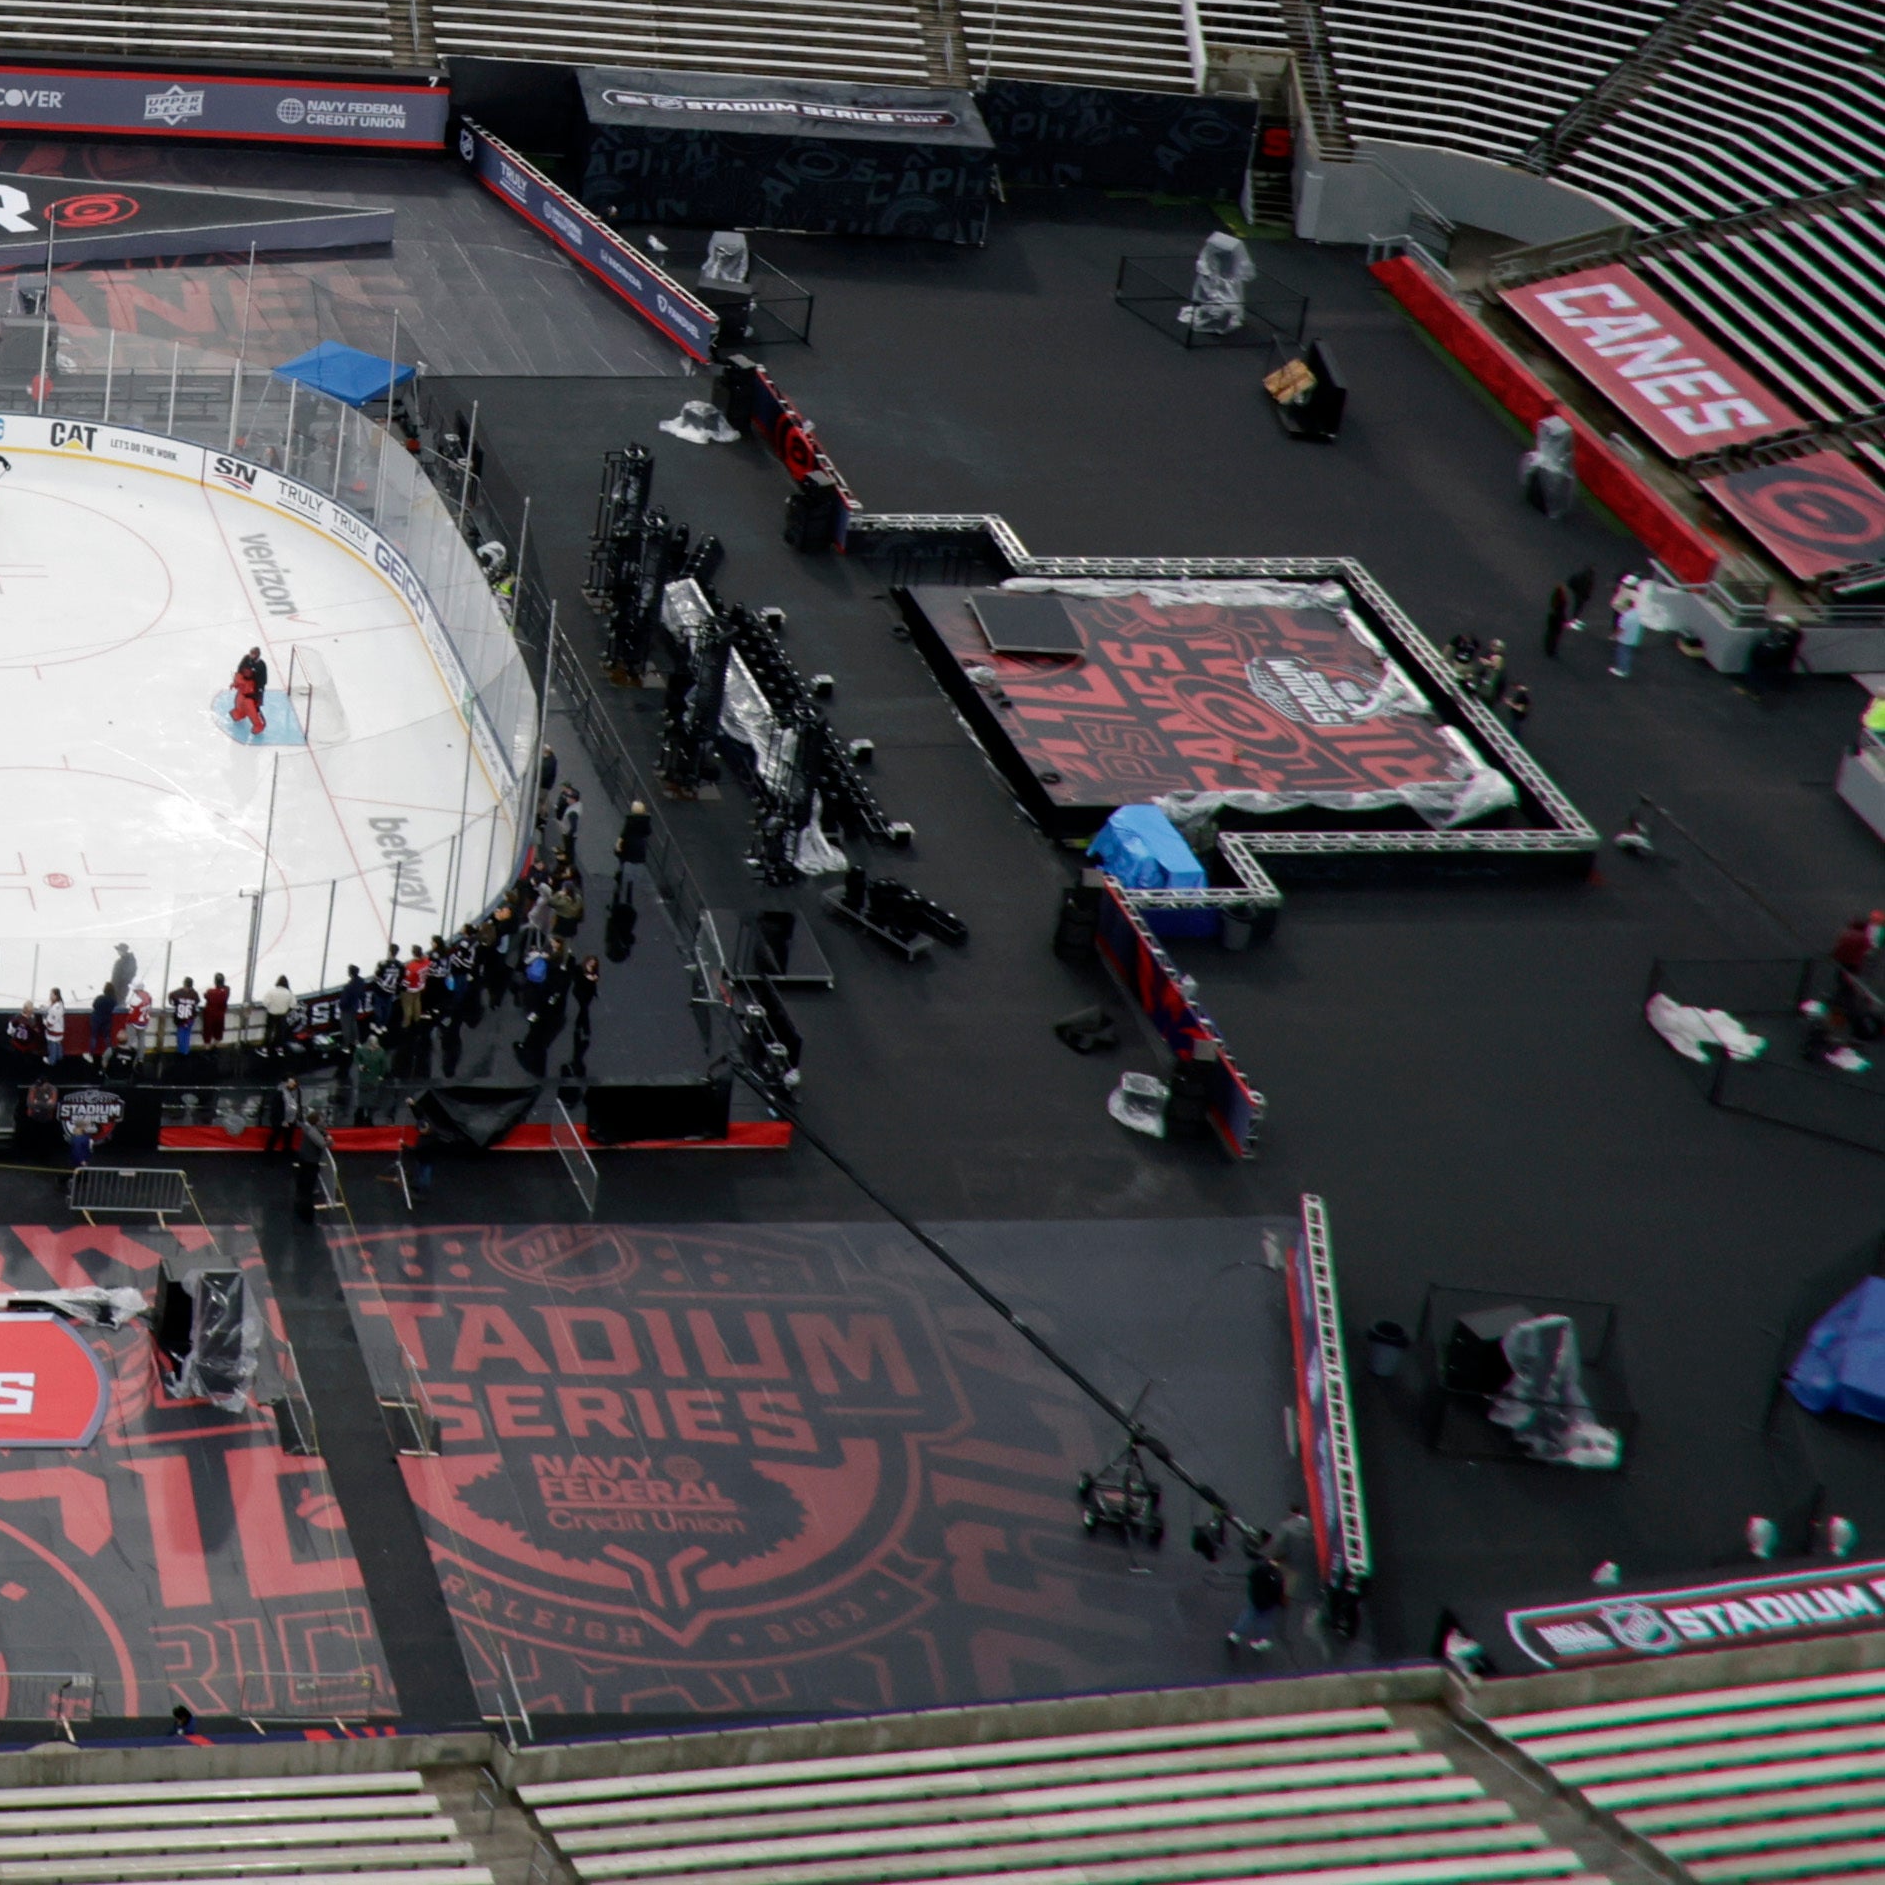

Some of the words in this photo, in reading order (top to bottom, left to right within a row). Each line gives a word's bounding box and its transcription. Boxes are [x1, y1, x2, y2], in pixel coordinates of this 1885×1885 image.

[429, 76, 438, 88] 7
[147, 94, 201, 109] UPPER
[307, 100, 345, 115] NAVY
[348, 102, 406, 117] FEDERAL
[686, 101, 798, 115] STADIUM
[803, 106, 894, 123] SERIES
[306, 113, 360, 127] CREDIT
[363, 114, 406, 128] UNION
[1261, 128, 1292, 157] S
[500, 161, 529, 193] TRULY
[1535, 278, 1771, 438] CANES
[51, 422, 98, 452] CAT
[111, 439, 128, 450] LET'S
[141, 444, 155, 456] THE
[157, 447, 177, 460] WORK
[278, 481, 324, 513] TRULY
[332, 508, 370, 542] TRULY
[240, 532, 297, 615] verizon
[374, 542, 427, 623] GEICO
[1266, 660, 1343, 724] STADIUM
[367, 817, 437, 914] betway
[177, 1004, 193, 1019] 96
[59, 1103, 122, 1118] STADIUM
[412, 1382, 820, 1453] SERIES
[529, 1454, 653, 1480] NAVY
[538, 1477, 726, 1504] FEDERAL
[545, 1508, 646, 1533] Credit
[650, 1511, 747, 1536] Union
[439, 1573, 645, 1649] RALEIGH
[1662, 1583, 1884, 1642] STADIUM
